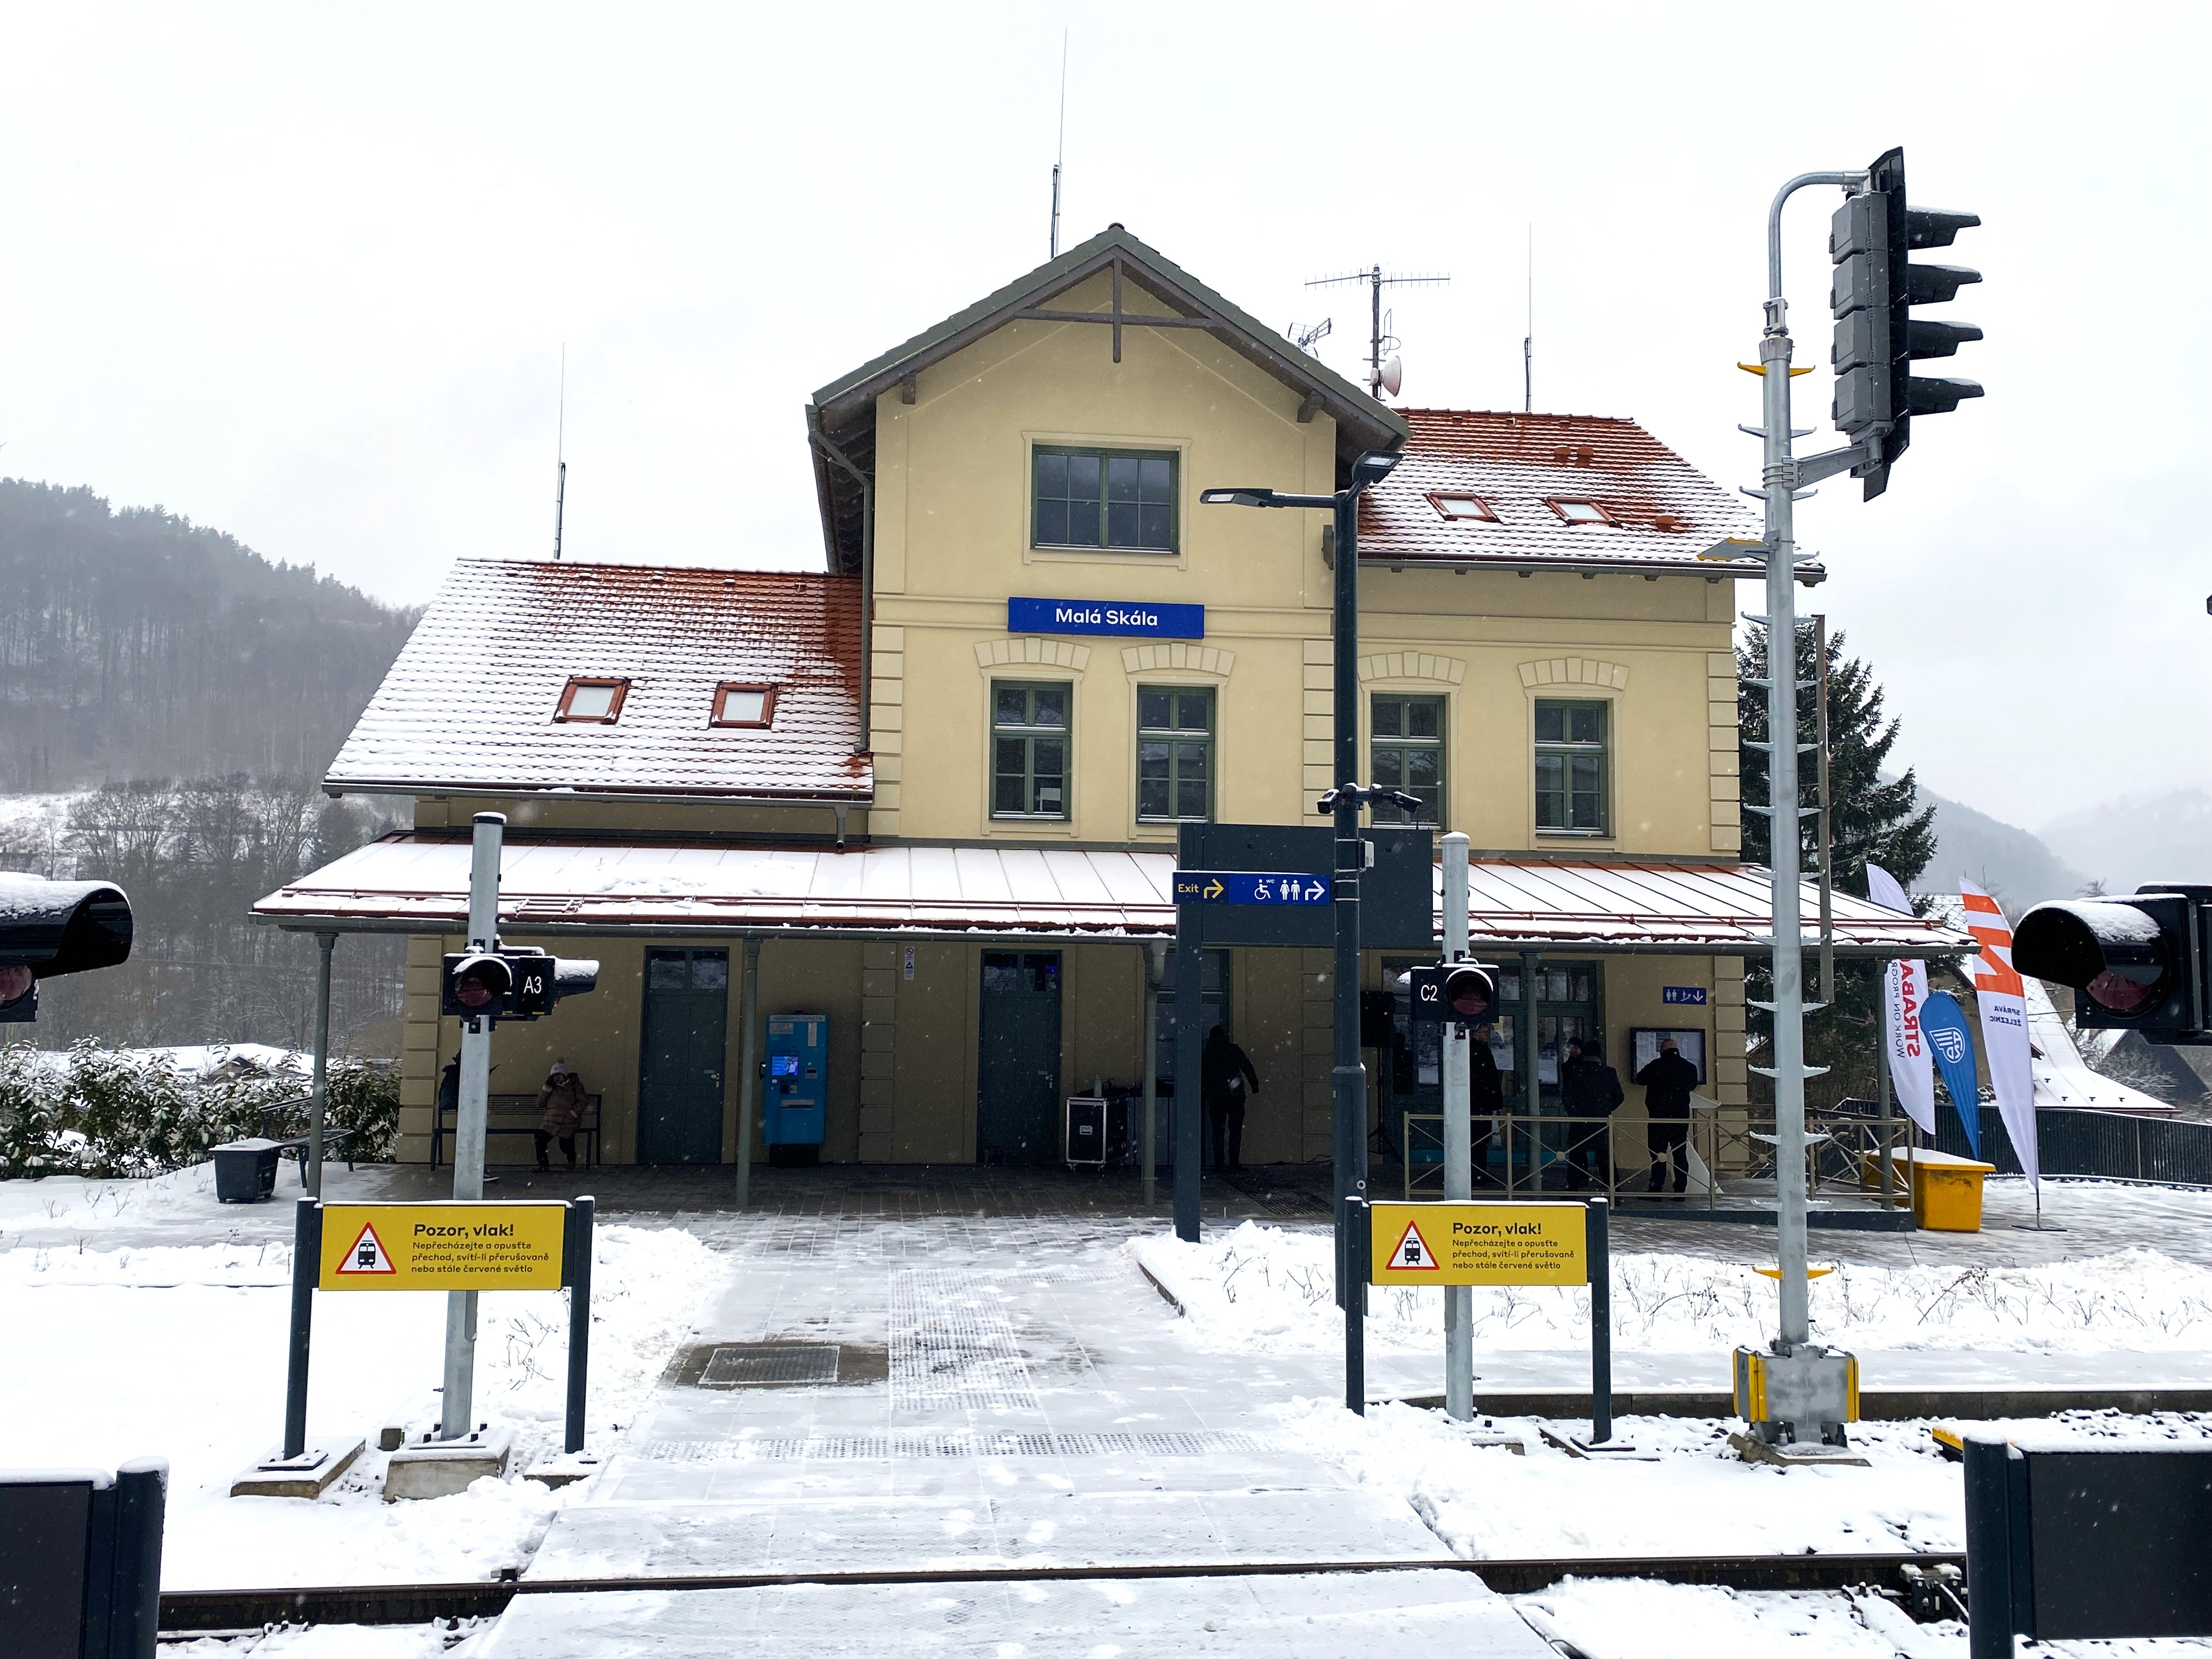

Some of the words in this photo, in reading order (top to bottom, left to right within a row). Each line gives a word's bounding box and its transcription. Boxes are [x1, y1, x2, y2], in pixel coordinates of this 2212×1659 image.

[1056, 608, 1101, 624] Malá
[1105, 610, 1158, 626] Skála
[1178, 884, 1199, 893] Exit
[523, 977, 542, 994] A3
[1421, 985, 1437, 1001] C2
[414, 1224, 469, 1239] Pozor,
[473, 1223, 514, 1236] vlak!
[1453, 1222, 1502, 1237] Pozor,
[1505, 1222, 1541, 1234] vlak!
[413, 1242, 483, 1251] Nepřecházejte
[494, 1242, 531, 1251] opusťte
[1453, 1239, 1515, 1248] Nepřecházejte
[1525, 1240, 1558, 1248] opusťte
[412, 1253, 454, 1262] přechod,
[489, 1253, 549, 1262] přerušovaně
[1453, 1250, 1490, 1259] přechod,
[1521, 1251, 1574, 1259] přerušovaně
